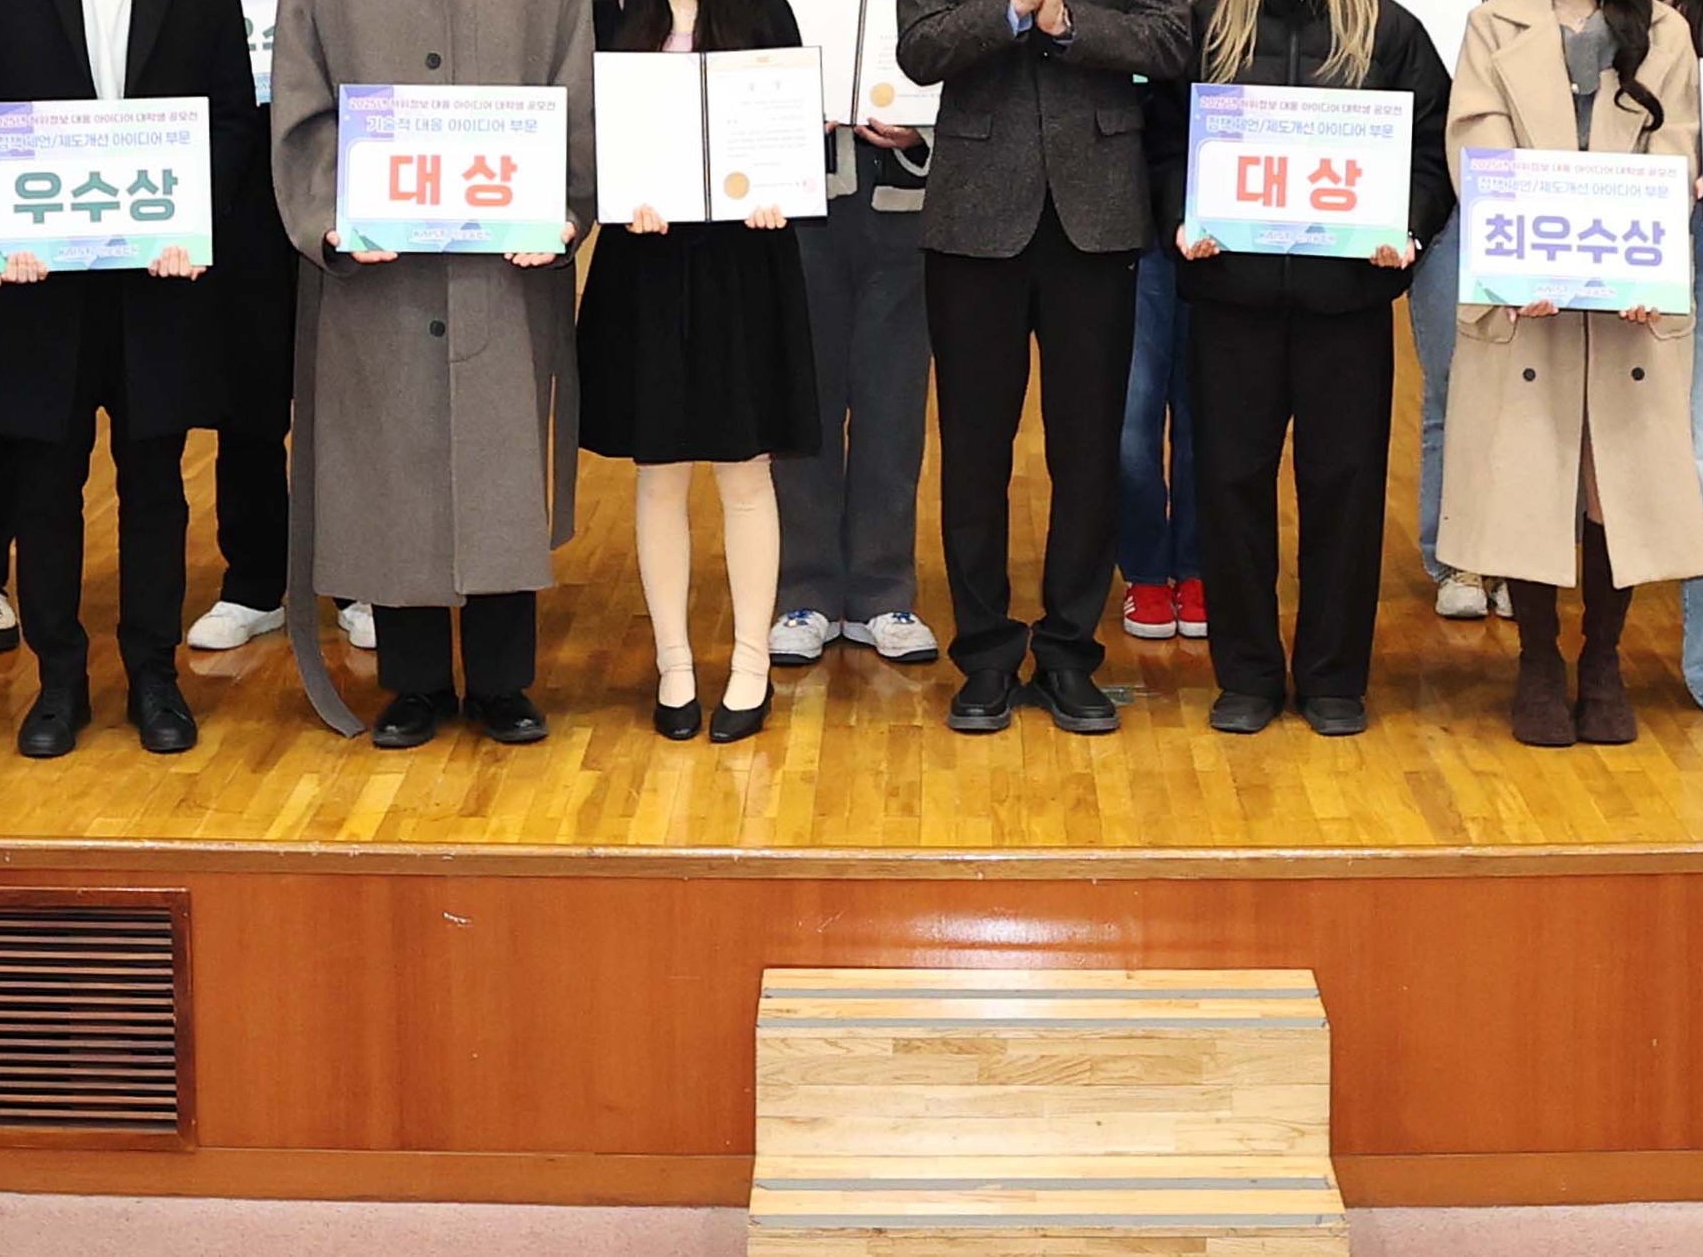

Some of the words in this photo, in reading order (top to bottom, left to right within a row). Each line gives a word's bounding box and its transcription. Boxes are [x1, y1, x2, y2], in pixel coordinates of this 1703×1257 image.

[113, 132, 162, 146] 아이디어
[448, 119, 505, 132] 아이디어
[510, 119, 538, 133] 부문
[13, 169, 178, 223] 우수상
[1485, 214, 1665, 266] 최우수상
